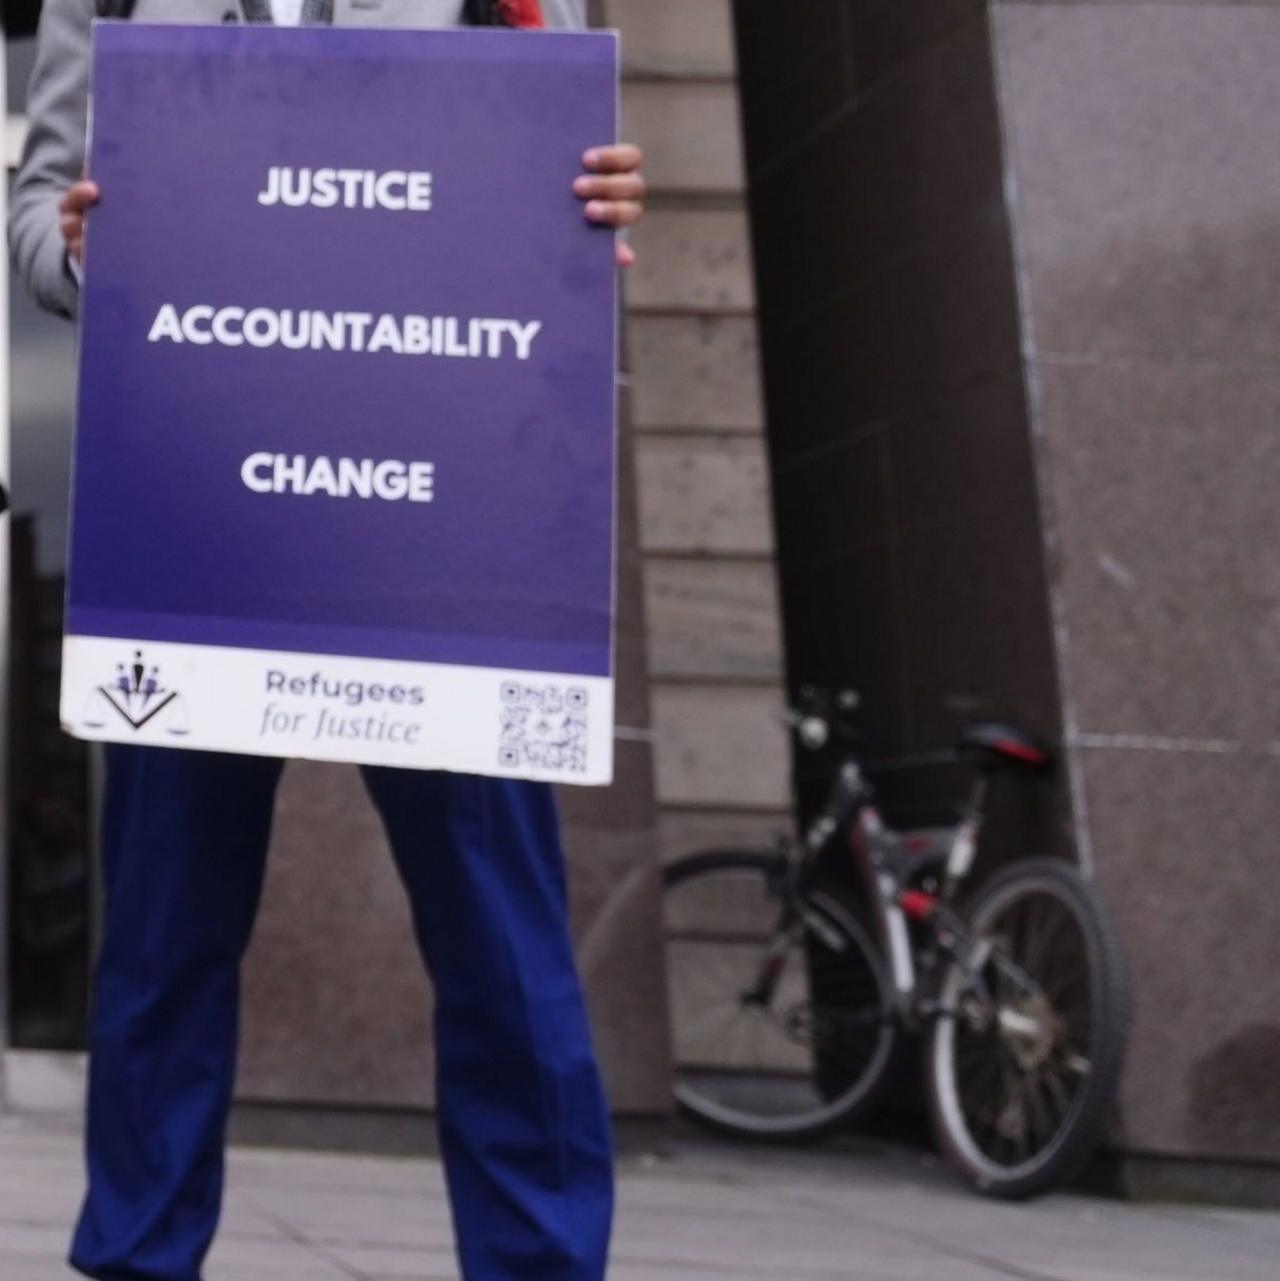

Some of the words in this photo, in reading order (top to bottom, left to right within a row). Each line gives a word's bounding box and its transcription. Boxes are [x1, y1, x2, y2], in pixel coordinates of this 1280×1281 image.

[257, 166, 433, 211] JUSTICE
[147, 303, 541, 360] ACCOUNTABILITY
[240, 451, 435, 502] CHANGE
[265, 670, 425, 706] Refugees
[259, 701, 306, 737] for
[313, 707, 423, 745] Justice
